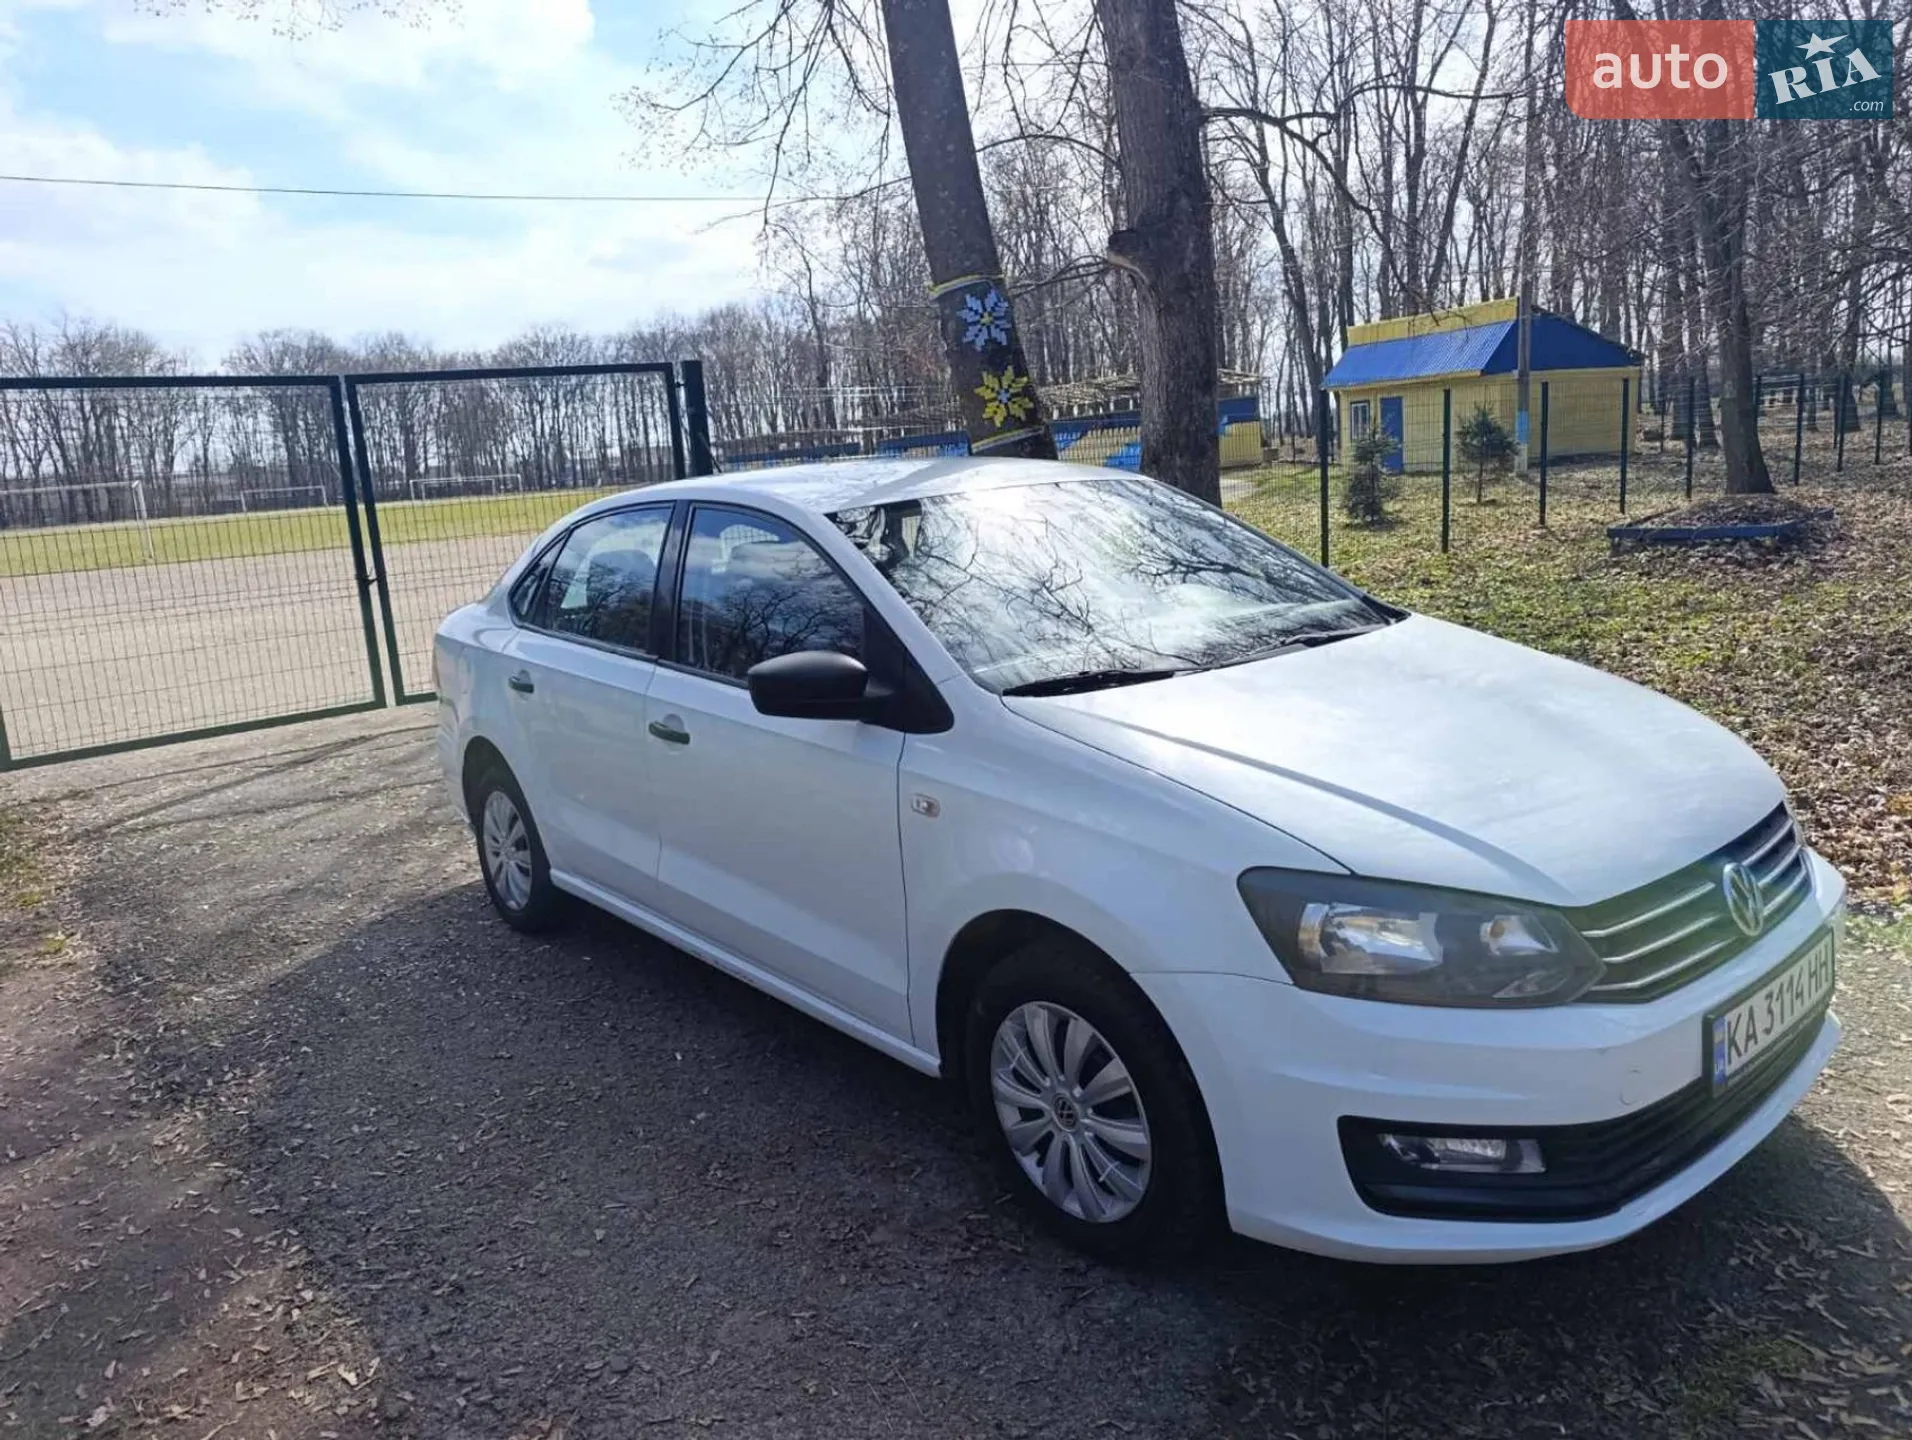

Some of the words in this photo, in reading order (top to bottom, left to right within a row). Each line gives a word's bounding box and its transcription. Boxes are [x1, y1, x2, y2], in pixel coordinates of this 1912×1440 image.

[1727, 1005, 1758, 1066] KA
[1762, 966, 1804, 1036] 3114
[1808, 943, 1830, 998] HH
